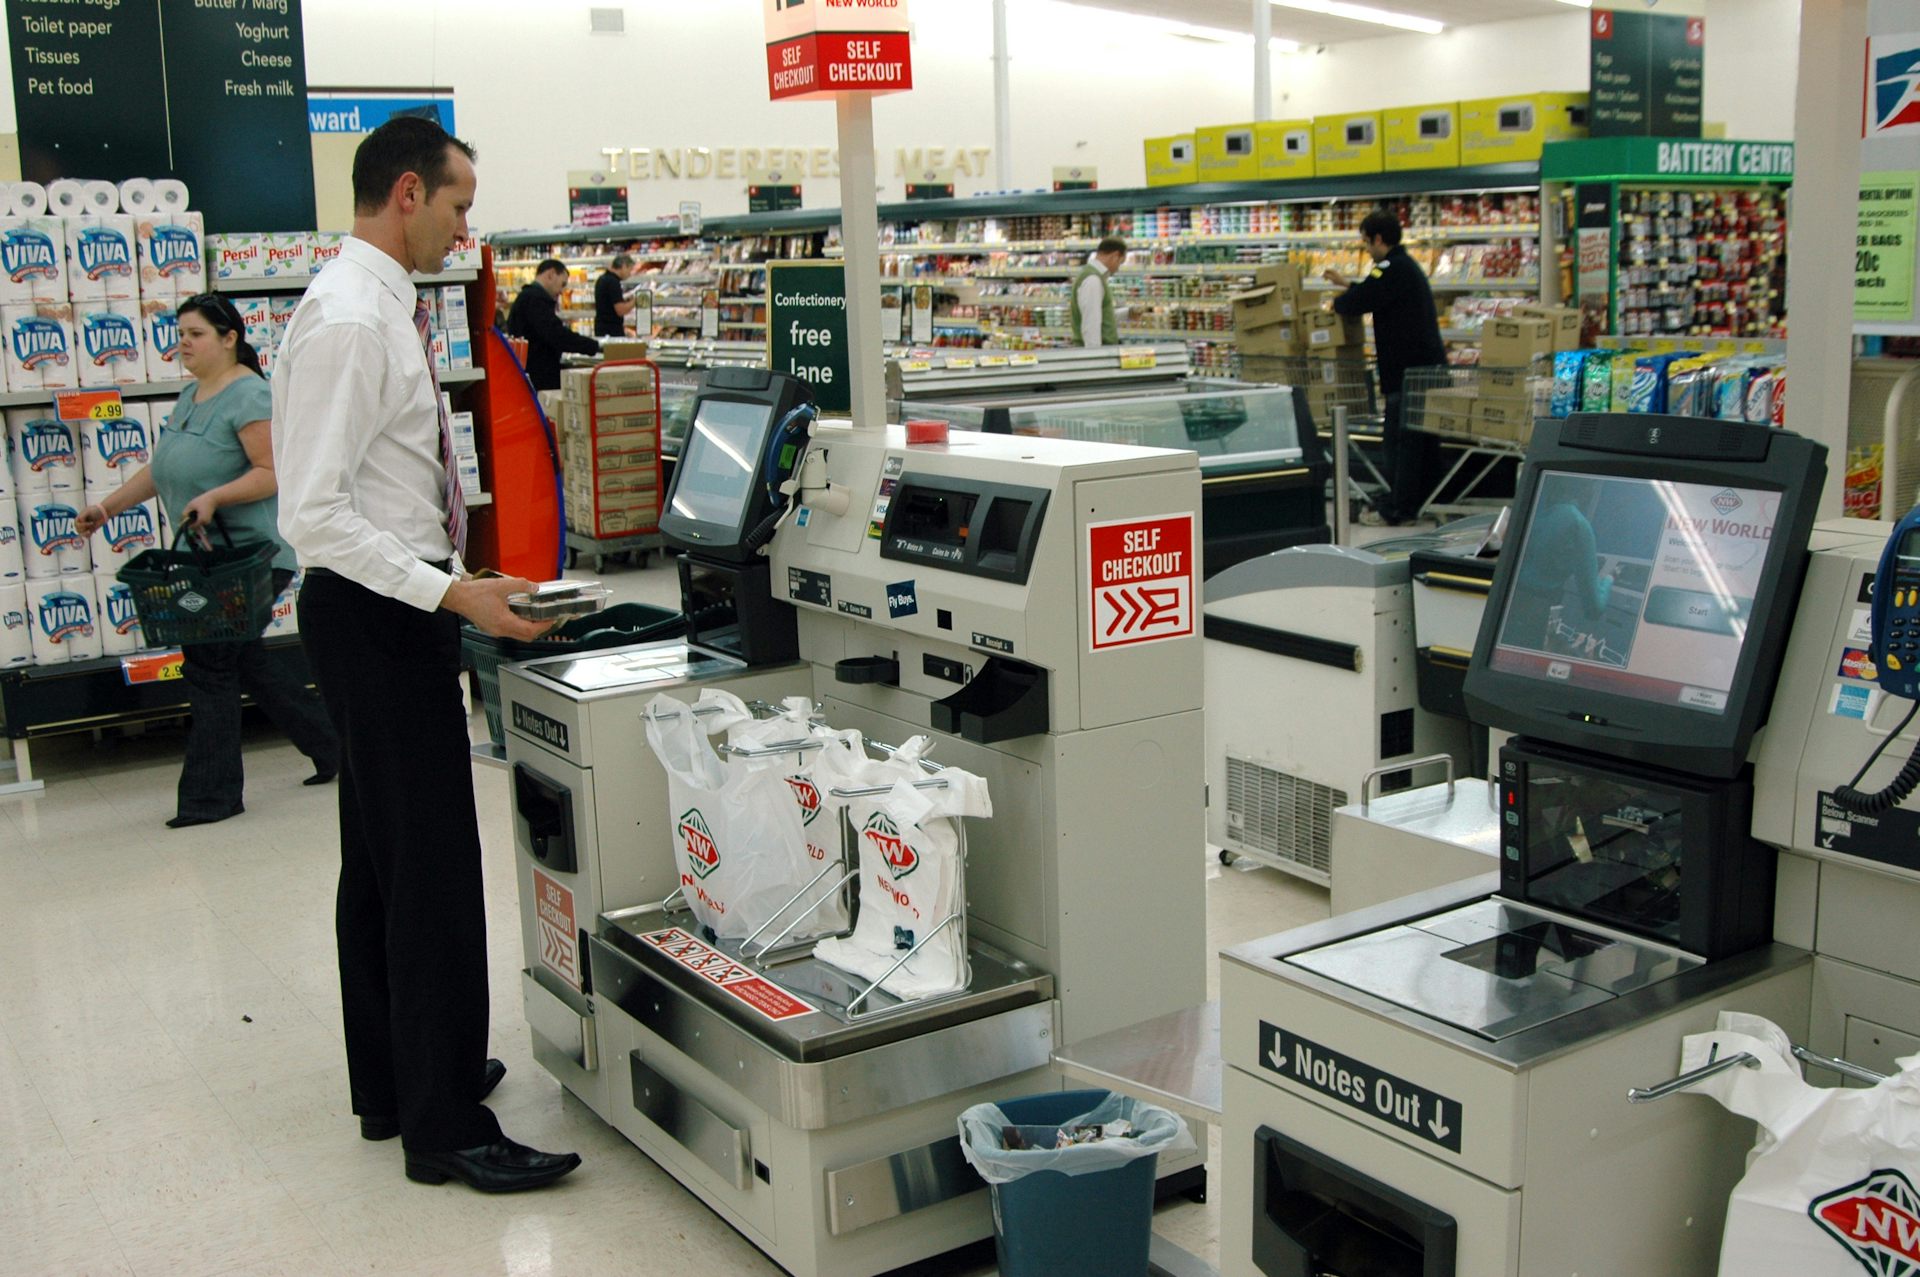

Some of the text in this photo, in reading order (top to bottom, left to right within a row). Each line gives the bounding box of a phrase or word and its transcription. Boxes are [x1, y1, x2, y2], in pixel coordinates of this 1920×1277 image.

[22, 15, 112, 38] Toilet paper
[235, 21, 290, 43] Yoghurt
[1596, 13, 1608, 34] 6
[24, 46, 80, 64] Tissues
[241, 50, 292, 68] Cheese
[781, 45, 802, 67] SELF
[846, 40, 881, 60] SELF
[773, 65, 815, 91] CHECKOUT
[828, 62, 903, 82] CHECKOUT
[28, 77, 94, 95] Pet food
[224, 79, 294, 97] Fresh milk
[894, 147, 991, 178] MEAT
[1657, 141, 1735, 174] BATTERY
[154, 239, 197, 266] VIVA
[223, 245, 258, 262] Persil
[268, 243, 303, 261] Persil
[1870, 234, 1902, 247] BAGS
[5, 244, 53, 271] VIVA
[82, 242, 127, 270] VIVA
[774, 292, 846, 310] Confectionery
[17, 331, 64, 358] VIVA
[88, 327, 133, 354] VIVA
[790, 319, 832, 347] free
[790, 357, 833, 384] lane
[94, 404, 122, 418] 2.99
[26, 433, 71, 460] VIVA
[101, 429, 145, 457] VIVA
[35, 516, 78, 544] VIVA
[108, 514, 150, 541] VIVA
[1123, 527, 1161, 554] SELF
[1711, 518, 1774, 540] WORLD
[1102, 551, 1182, 582] CHECKOUT
[888, 596, 898, 609] Fly
[43, 605, 88, 632] VIVA
[522, 709, 559, 744] Notes Out
[1822, 805, 1880, 828] Below Scanner
[545, 883, 561, 908] SELF
[539, 898, 571, 935] CHECKOUT
[1295, 1042, 1421, 1128] Notes Out
